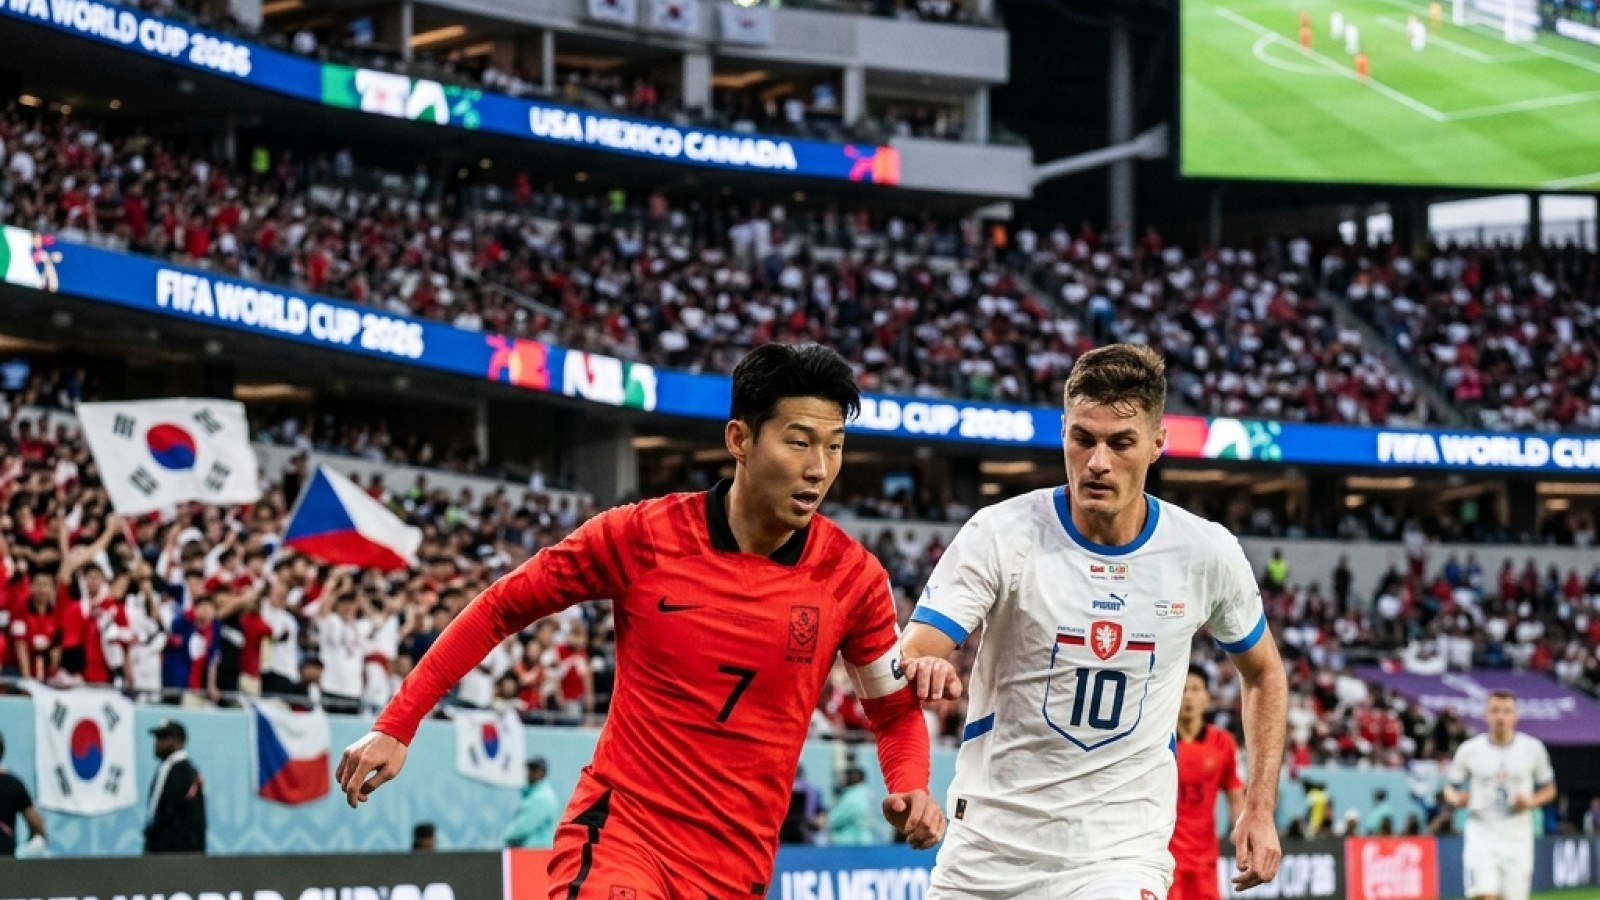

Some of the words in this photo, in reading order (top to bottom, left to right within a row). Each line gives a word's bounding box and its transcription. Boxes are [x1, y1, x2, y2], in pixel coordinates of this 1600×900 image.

[51, 0, 138, 44] WORLD
[138, 18, 189, 57] CUP
[188, 33, 252, 77] 2026
[529, 106, 583, 141] USA
[585, 116, 682, 158] MEXICO
[683, 131, 797, 170] CANADA
[156, 268, 215, 316] FIFA
[214, 281, 308, 335] WORLD
[309, 302, 360, 345] CUP
[360, 313, 424, 359] 2026
[902, 401, 959, 435] CUP
[959, 407, 1035, 442] 2026
[1377, 432, 1439, 464] FIFA
[1438, 434, 1549, 467] WORLD
[715, 664, 757, 723] 7
[1070, 667, 1127, 731] 10
